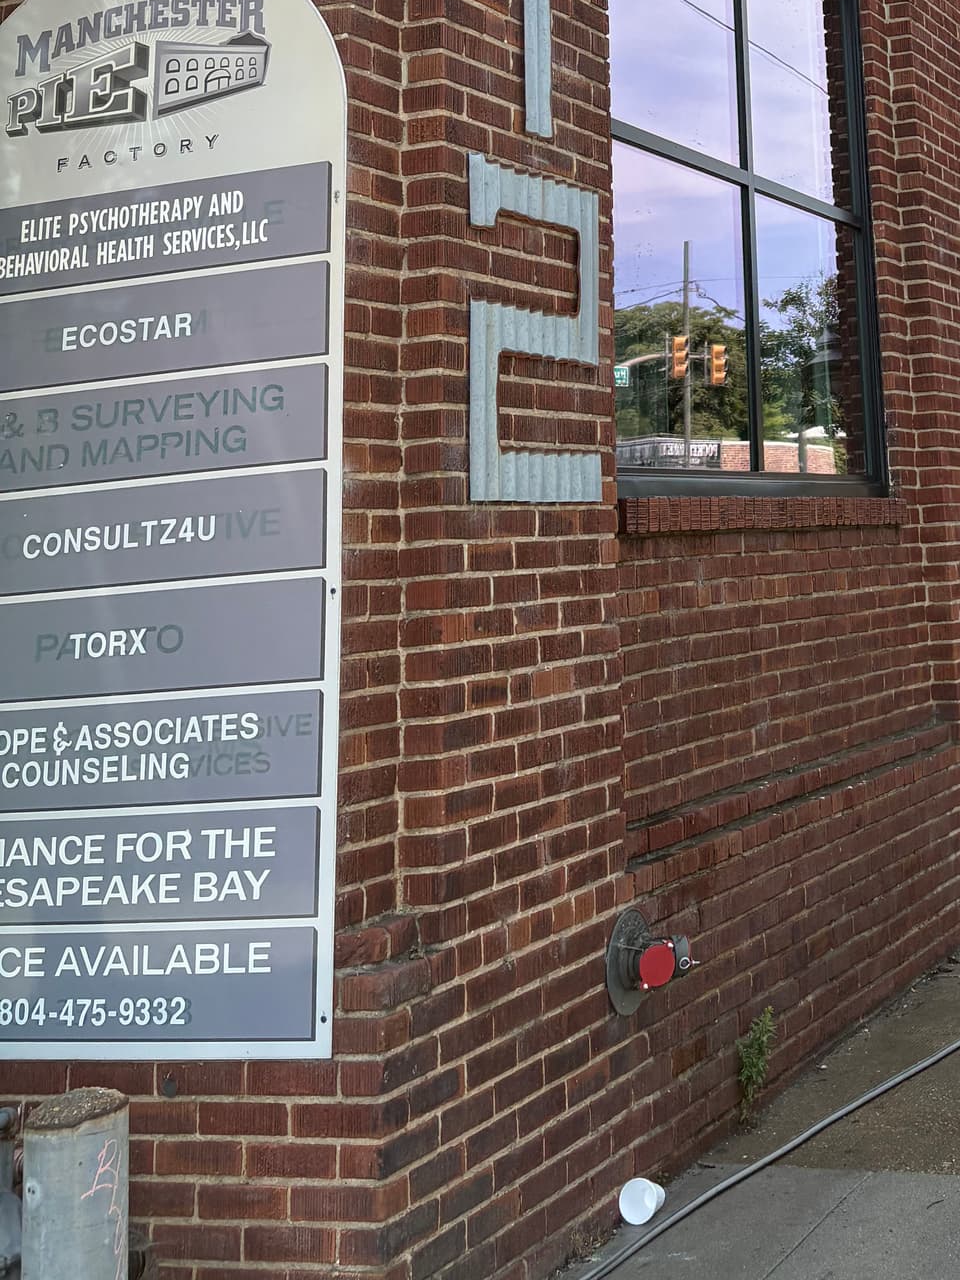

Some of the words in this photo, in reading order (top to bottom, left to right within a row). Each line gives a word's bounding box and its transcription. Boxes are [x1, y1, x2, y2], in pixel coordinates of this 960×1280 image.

[6, 41, 149, 137] PIE
[57, 134, 219, 172] FACTORY
[21, 216, 62, 243] ELITE
[69, 195, 204, 235] PSYCHOTHERAPY
[208, 190, 244, 217] AND
[0, 246, 89, 279] BEHAVIORAL
[97, 234, 154, 266] HEALTH
[61, 312, 193, 351] ECOSTAR
[71, 384, 285, 433] SURVEYING
[0, 444, 70, 474] AND
[81, 425, 247, 468] MAPPING
[23, 515, 216, 559] CONSULTZ4U
[70, 628, 147, 659] TORX
[53, 721, 73, 756] &
[74, 712, 260, 752] ASSOCIATES
[2, 752, 190, 789] COUNSELING
[116, 829, 192, 863] FOR
[201, 826, 276, 859] THE
[193, 869, 270, 903] BAY
[55, 942, 272, 977] AVAILABLE
[0, 997, 187, 1027] 804-475-9332
